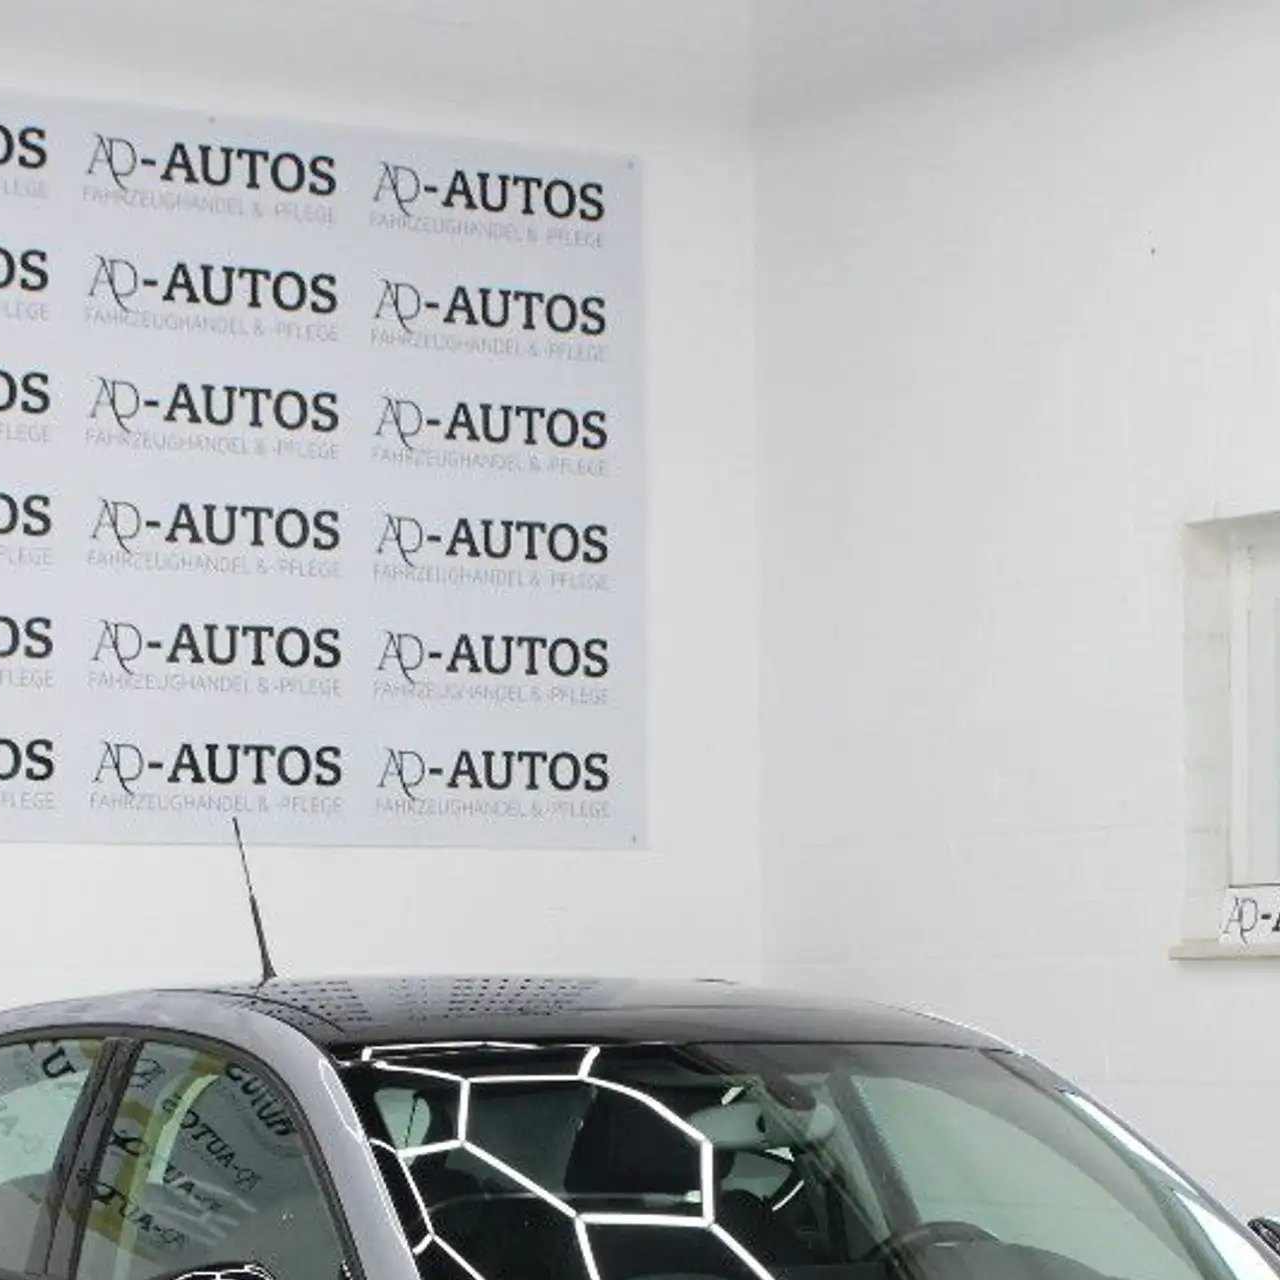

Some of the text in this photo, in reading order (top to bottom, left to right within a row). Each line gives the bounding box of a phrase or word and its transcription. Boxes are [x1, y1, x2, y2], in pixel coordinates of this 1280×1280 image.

[86, 132, 337, 196] AD-AUTOS
[372, 160, 606, 221] AD-AUTOS
[87, 255, 338, 315] AD-AUTOS
[373, 278, 607, 335] AD-AUTOS
[89, 377, 339, 433] AD-AUTOS
[374, 396, 607, 451] AD-AUTOS
[90, 498, 340, 555] AD-AUTOS
[375, 513, 608, 568] AD-AUTOS
[92, 620, 341, 675] AD-AUTOS
[376, 631, 609, 684] AD-AUTOS
[93, 741, 342, 796] AD-AUTOS
[377, 747, 609, 801] AD-AUTOS
